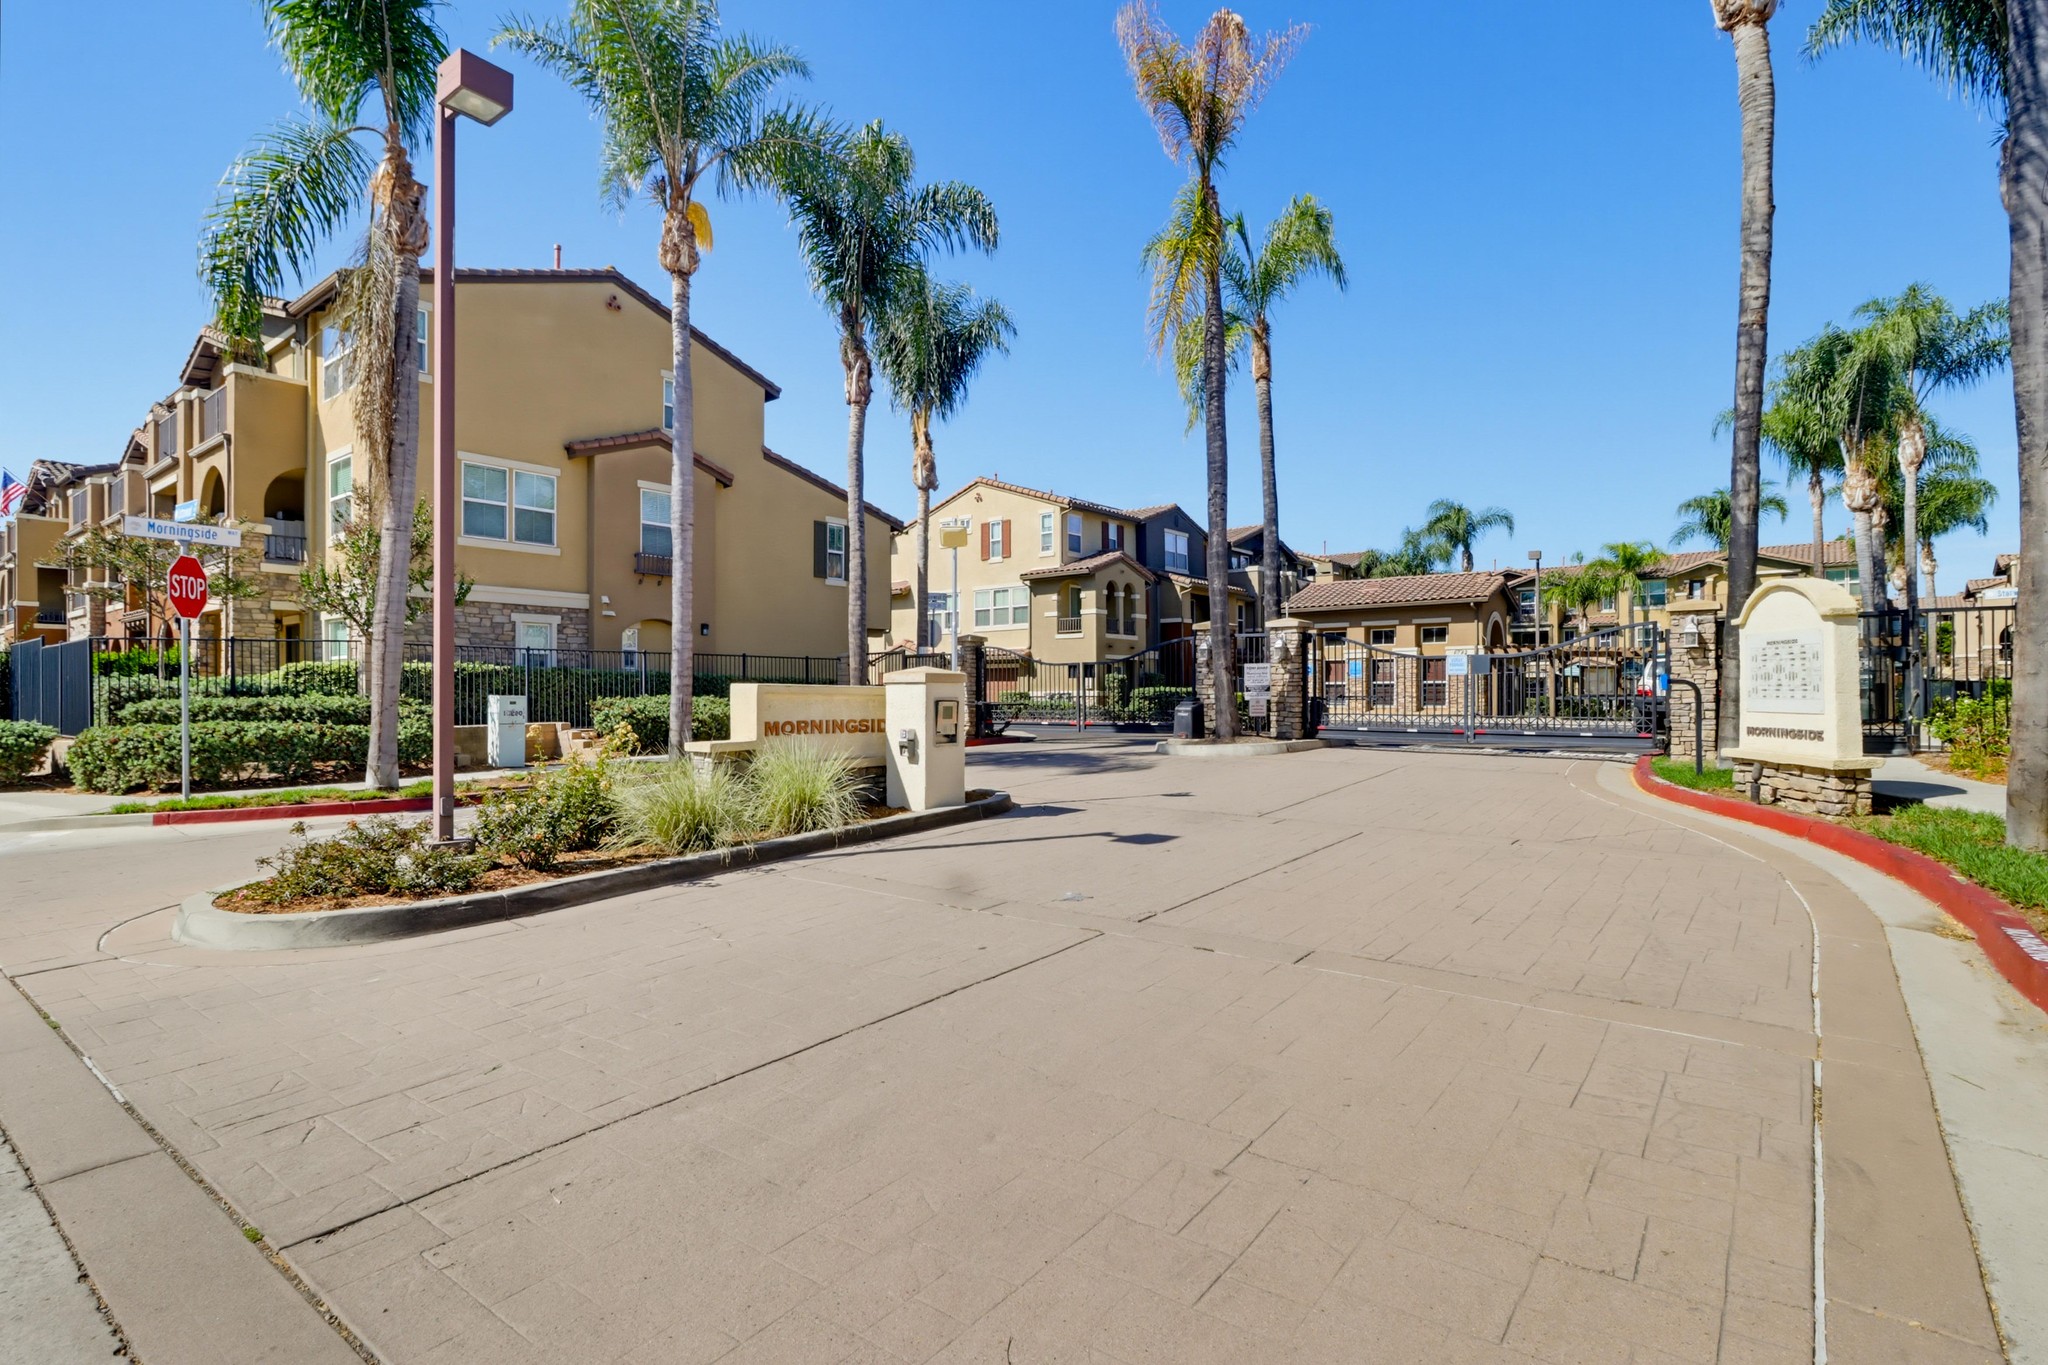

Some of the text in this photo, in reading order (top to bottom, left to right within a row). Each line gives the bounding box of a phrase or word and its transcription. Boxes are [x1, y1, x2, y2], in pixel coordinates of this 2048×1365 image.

[147, 521, 218, 540] Morningside
[171, 573, 206, 600] STOP
[764, 718, 886, 737] MORNINGSID
[1746, 726, 1825, 742] MORNINGSIDE
